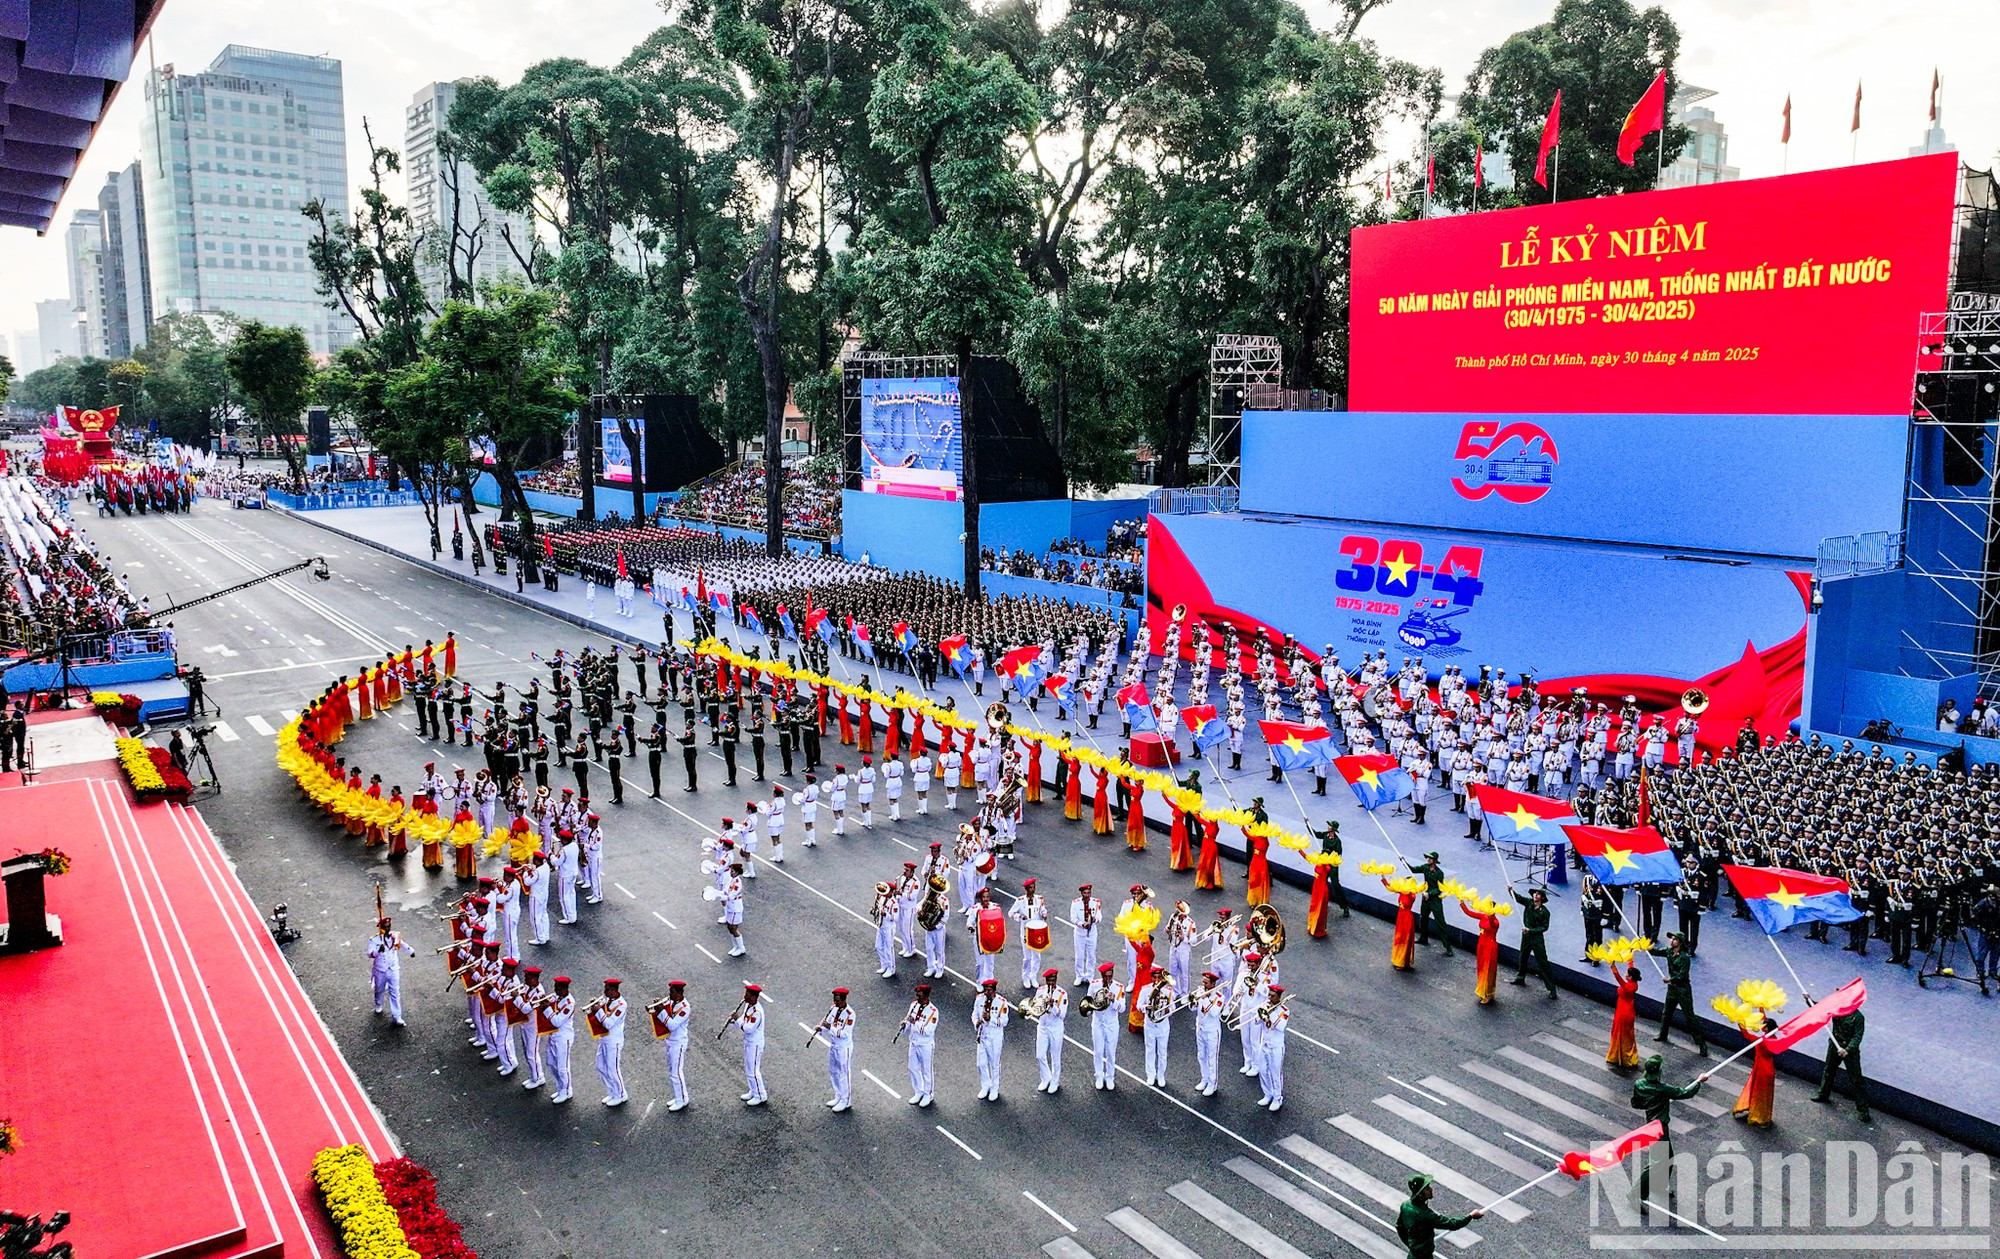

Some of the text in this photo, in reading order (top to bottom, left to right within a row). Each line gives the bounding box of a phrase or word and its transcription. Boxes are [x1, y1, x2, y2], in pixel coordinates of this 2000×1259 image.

[1500, 217, 1708, 268] LỄ KỶ NIỆM
[1379, 256, 1892, 315] 50 NĂM NGÀY GIẢI PHÓNG MIỀN NAM, THỐNG NHẤT ĐẤT NƯỚC
[1504, 306, 1586, 330] (30/4/1975
[1602, 298, 1696, 324] 30/4/2025)
[1455, 347, 1760, 370] Thành phố Hồ Chí Minh, ngày 30 tháng 4 năm 2025
[1450, 420, 1559, 504] 50
[1335, 535, 1484, 606] 30-4
